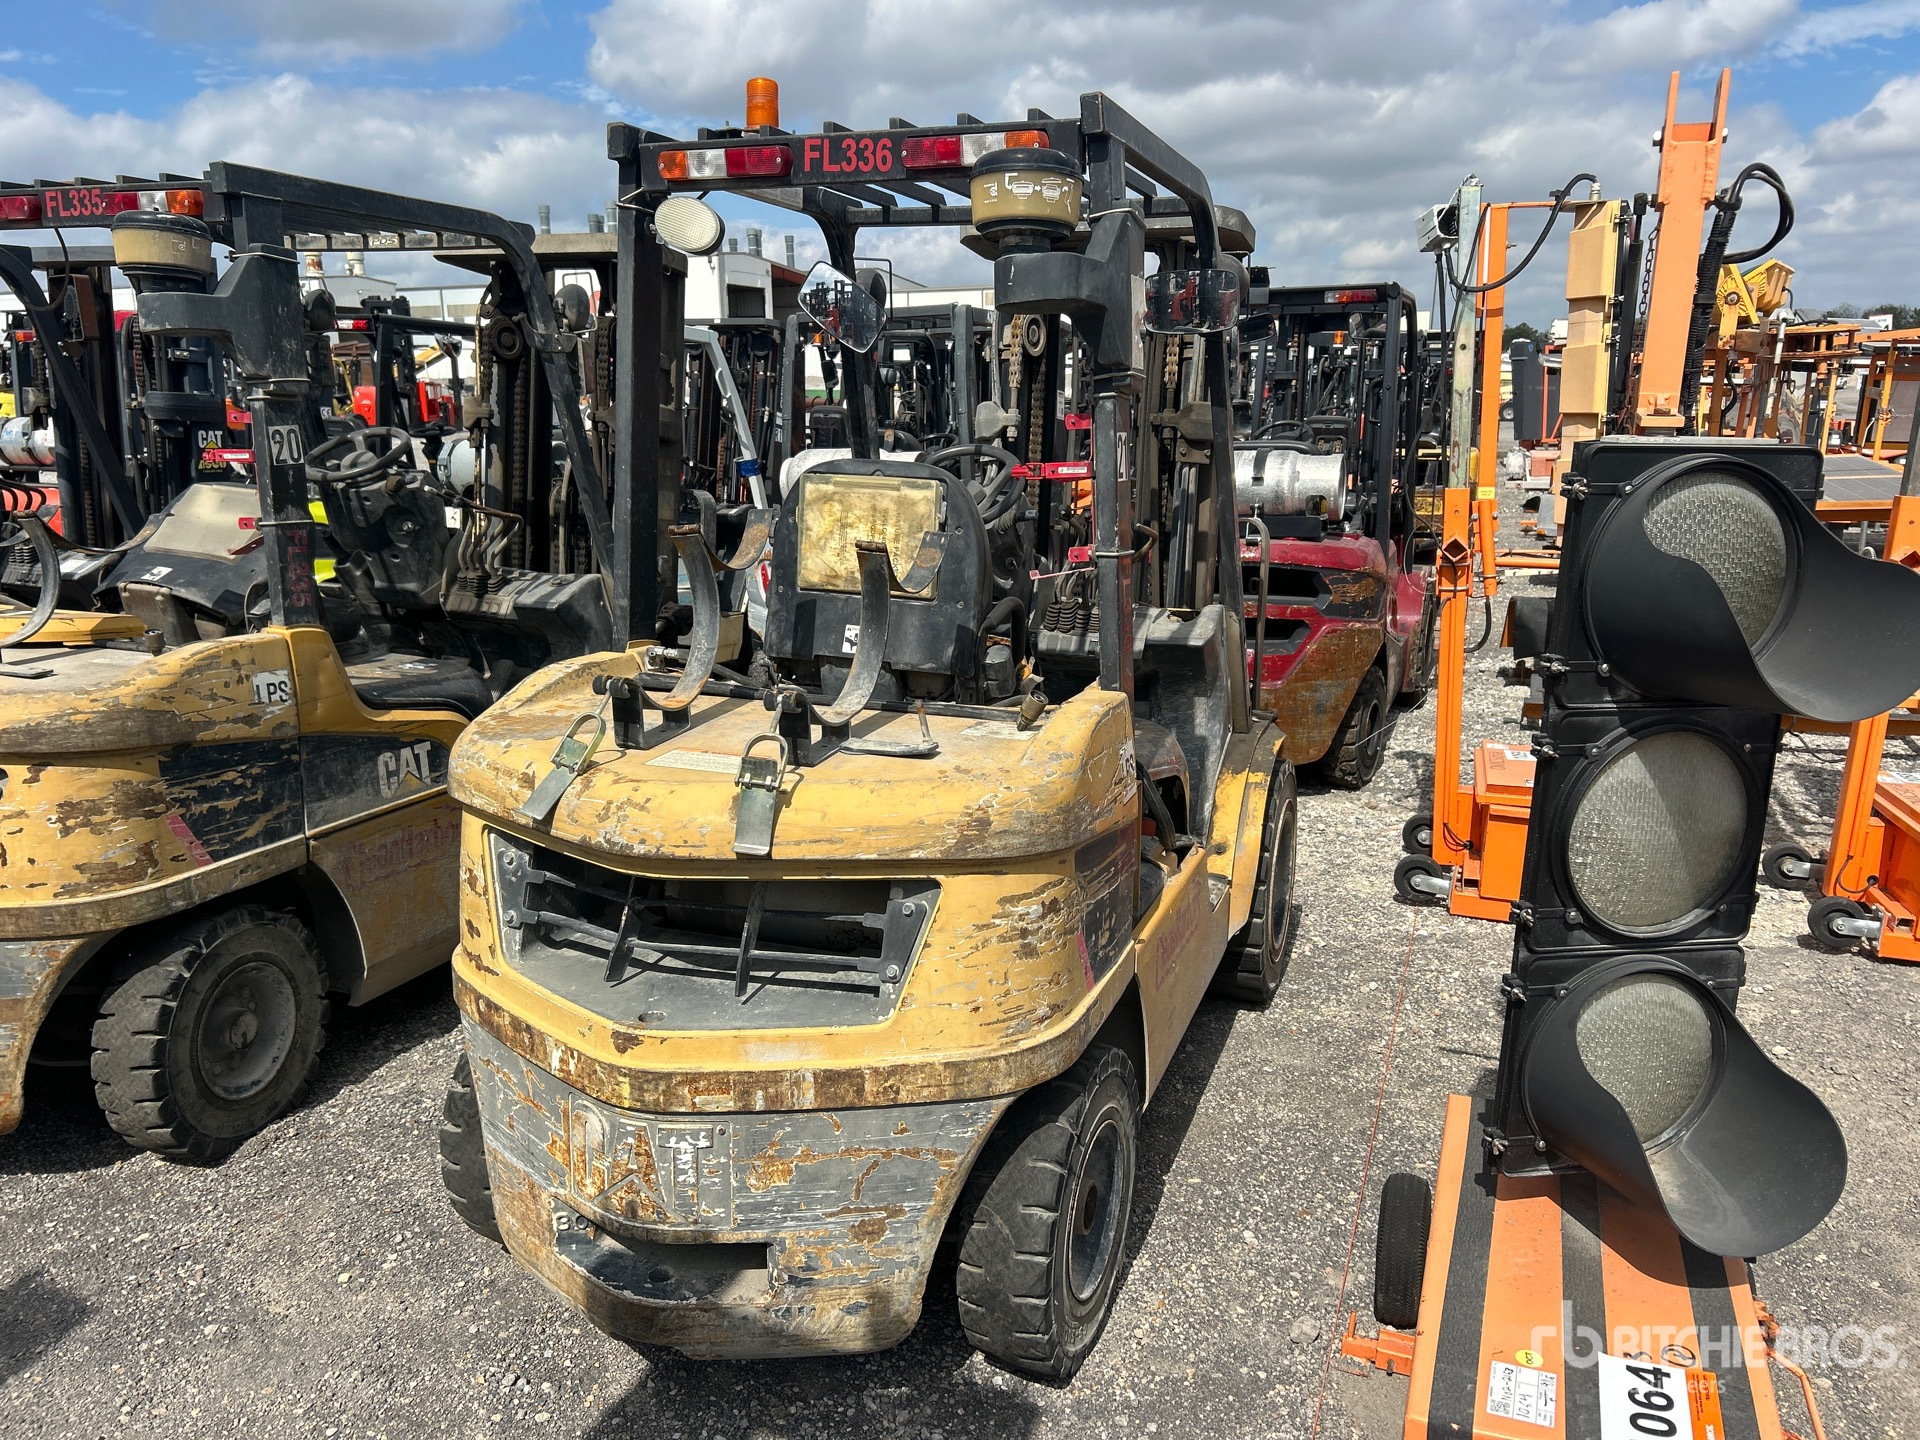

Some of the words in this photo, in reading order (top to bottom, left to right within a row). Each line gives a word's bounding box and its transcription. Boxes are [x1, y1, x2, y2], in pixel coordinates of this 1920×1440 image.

[803, 136, 893, 173] FL336
[45, 188, 103, 218] FL335
[197, 430, 223, 449] CAT
[271, 428, 302, 464] 20
[1117, 434, 1128, 480] 21
[377, 741, 432, 799] CAT
[570, 1100, 714, 1224] CAT
